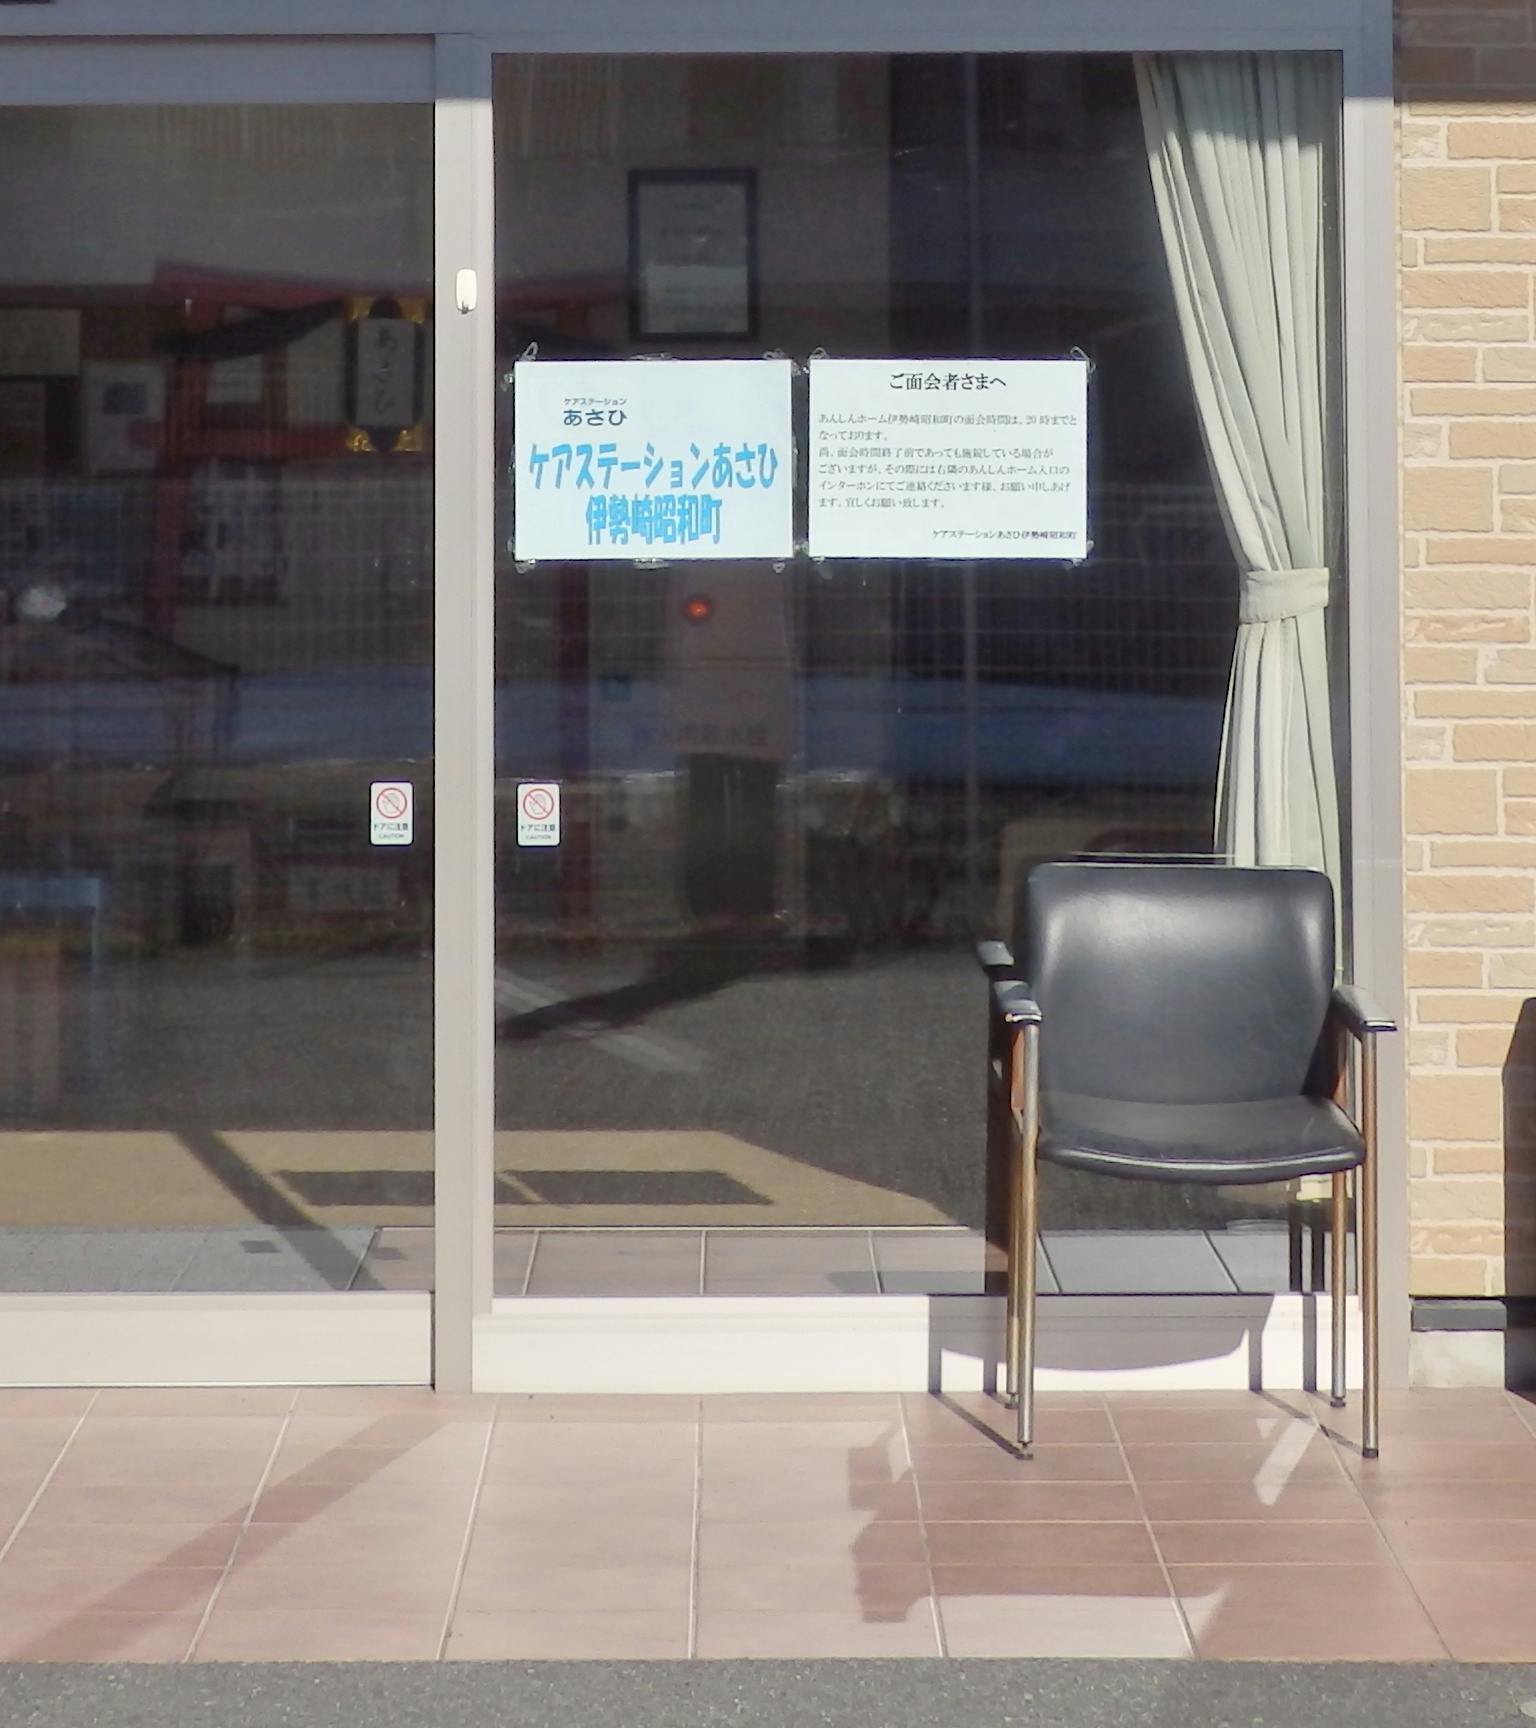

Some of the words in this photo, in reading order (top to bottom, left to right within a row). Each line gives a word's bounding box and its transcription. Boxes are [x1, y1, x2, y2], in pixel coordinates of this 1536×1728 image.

[889, 372, 1007, 391] ご面会者さまへ
[564, 397, 627, 406] ケアステーション
[564, 408, 627, 427] あさひ
[529, 442, 779, 490] ケアステーションあさひ
[585, 493, 723, 546] 伊勢崎昭和町
